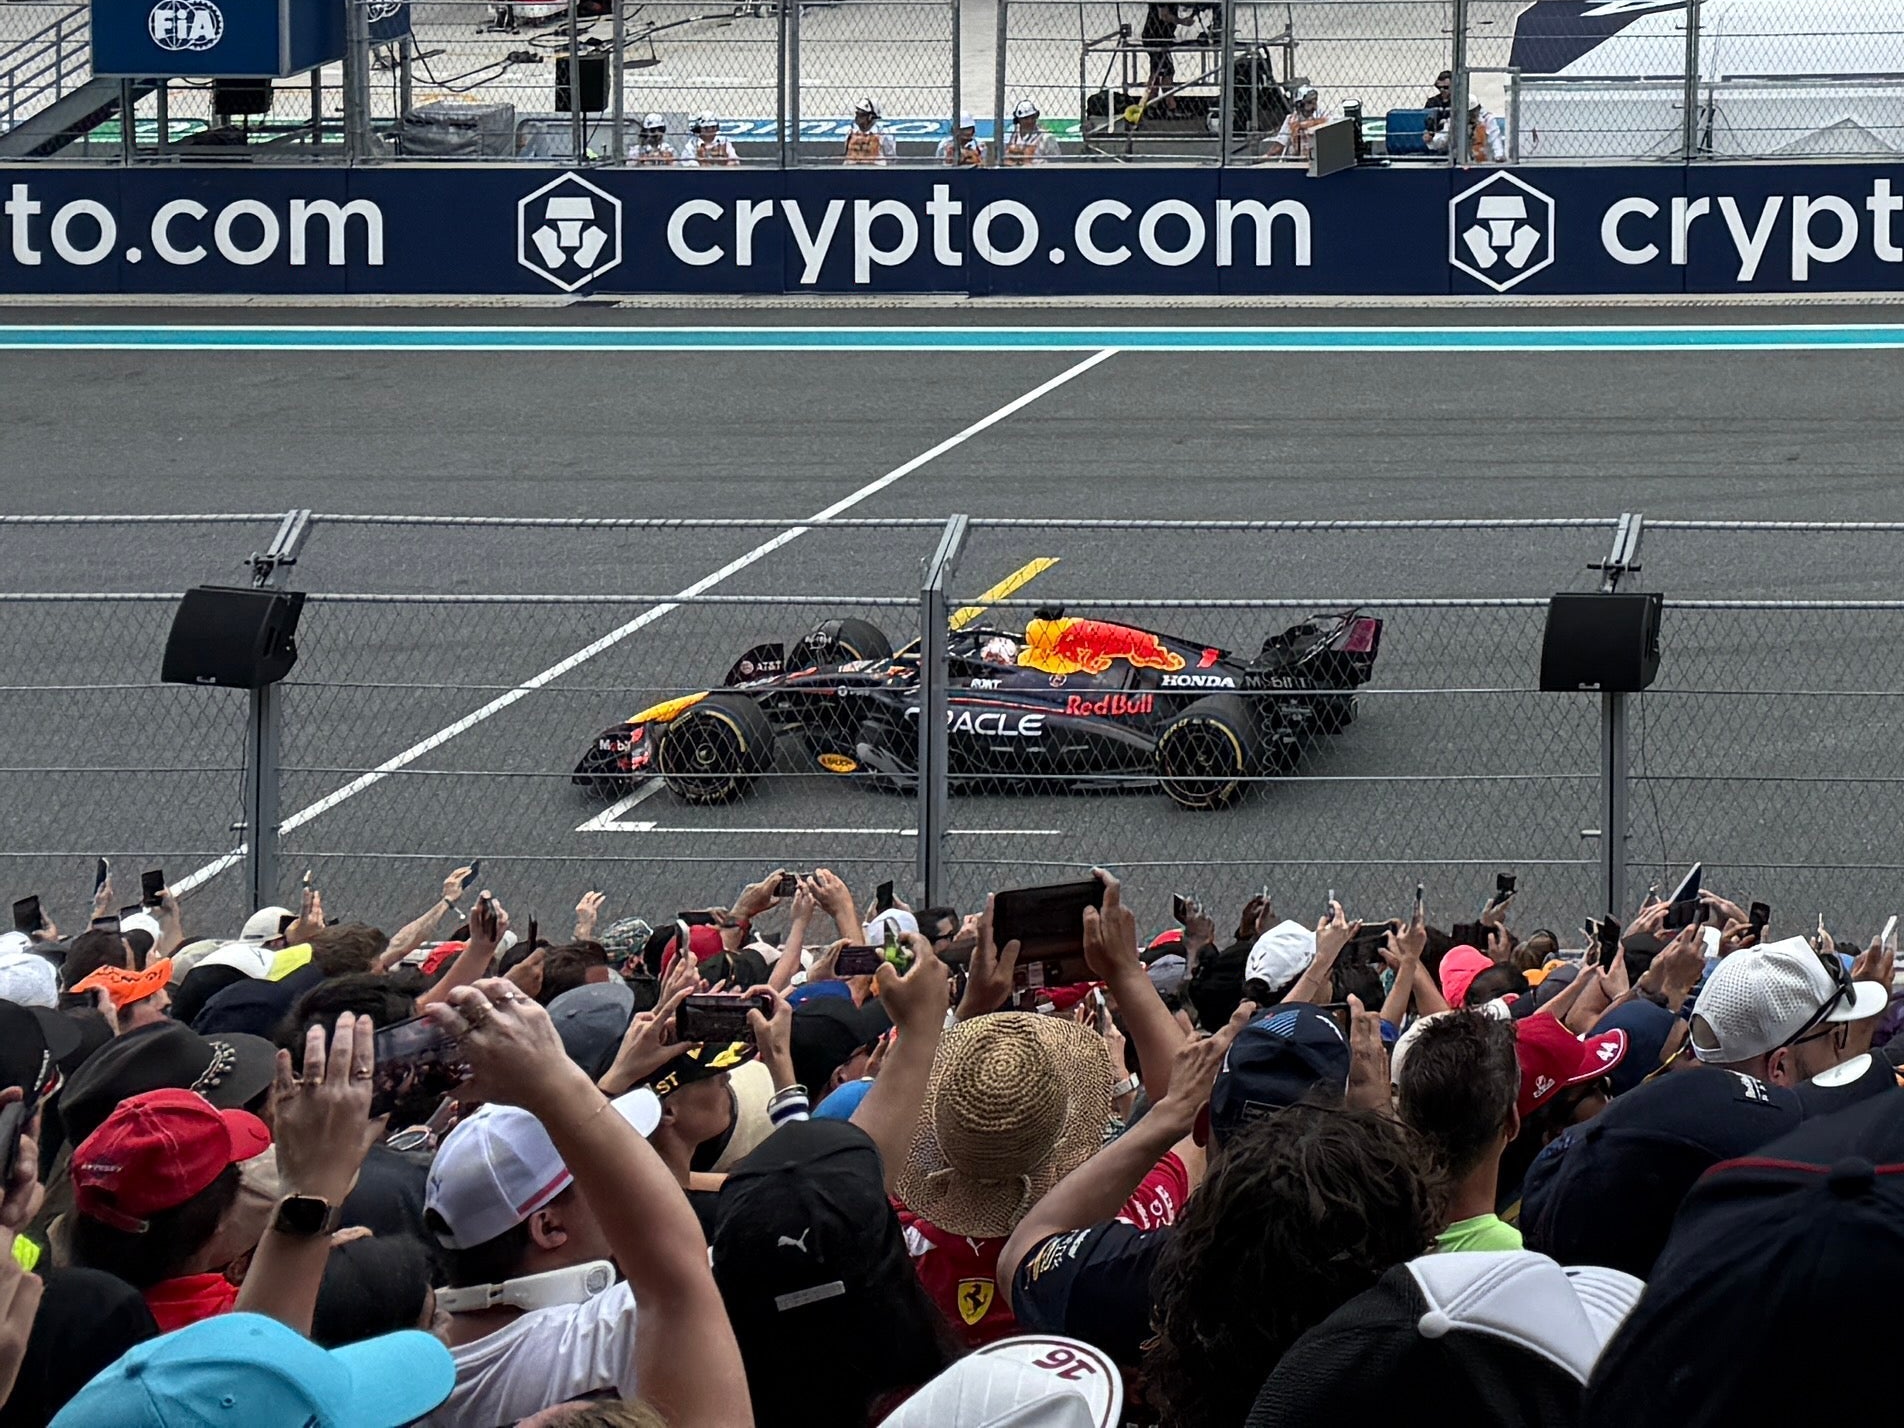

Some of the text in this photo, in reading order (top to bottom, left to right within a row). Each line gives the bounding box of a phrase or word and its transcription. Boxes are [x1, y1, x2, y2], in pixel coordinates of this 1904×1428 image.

[666, 184, 1311, 284] crypto.com
[756, 660, 782, 672] AT&T
[1160, 675, 1236, 689] HONDA
[1595, 1041, 1620, 1063] 44
[1032, 1348, 1098, 1383] 16
